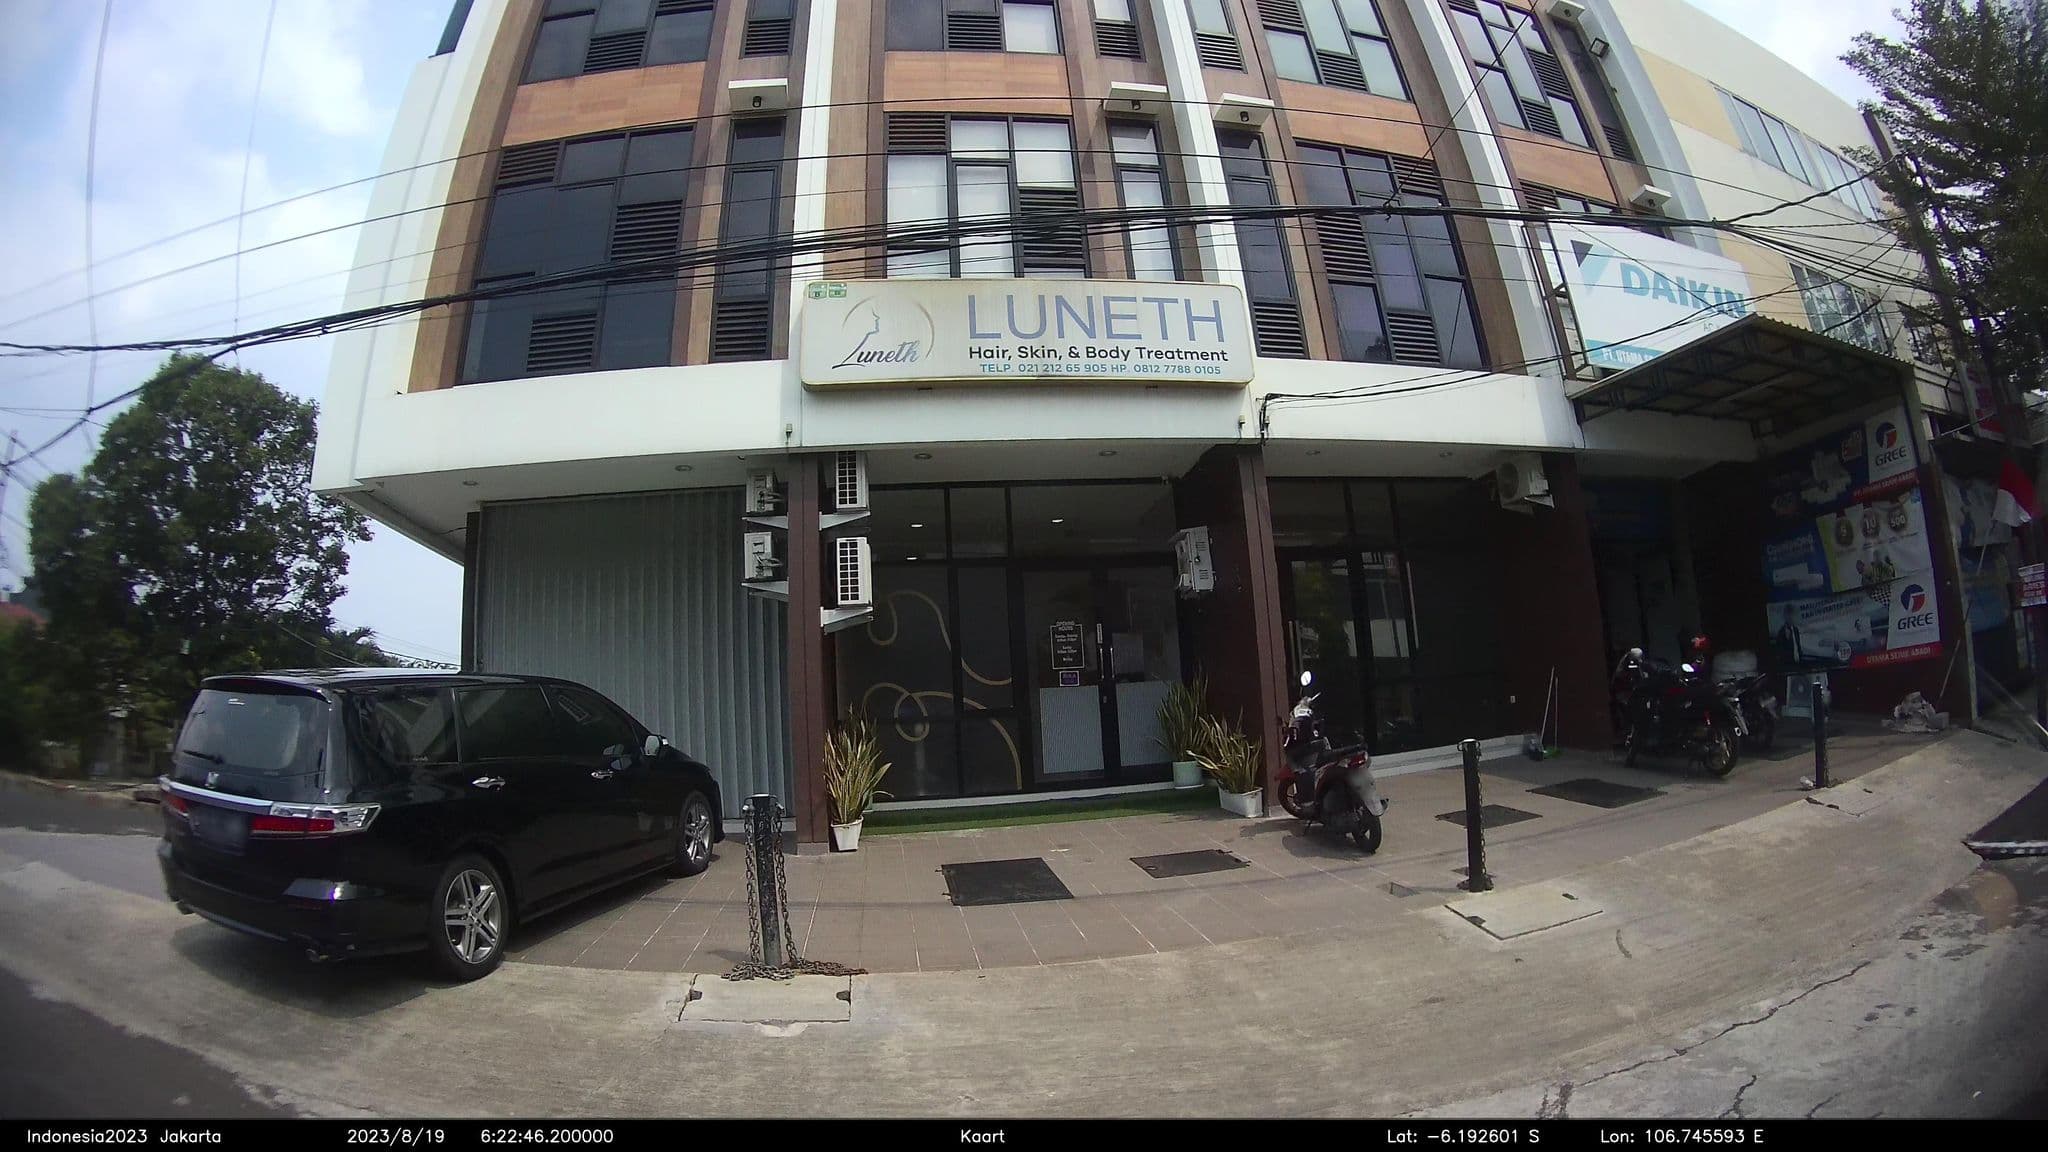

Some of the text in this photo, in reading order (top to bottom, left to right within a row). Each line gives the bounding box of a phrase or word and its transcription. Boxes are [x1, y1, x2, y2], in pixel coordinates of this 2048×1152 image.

[1620, 262, 1747, 318] DAIKIN
[968, 295, 1224, 342] LUNETH
[832, 330, 920, 369] Luneth
[969, 346, 1228, 361] Hair, Skin, & Body Treatment
[1018, 364, 1038, 372] 021
[1043, 364, 1061, 373] 212
[1066, 364, 1080, 373] 65
[1084, 364, 1107, 373] 905
[1133, 364, 1160, 373] 0812
[1164, 365, 1190, 374] 7788
[1194, 366, 1221, 375] 0105
[1875, 446, 1907, 466] GREE
[1898, 613, 1934, 630] GREE
